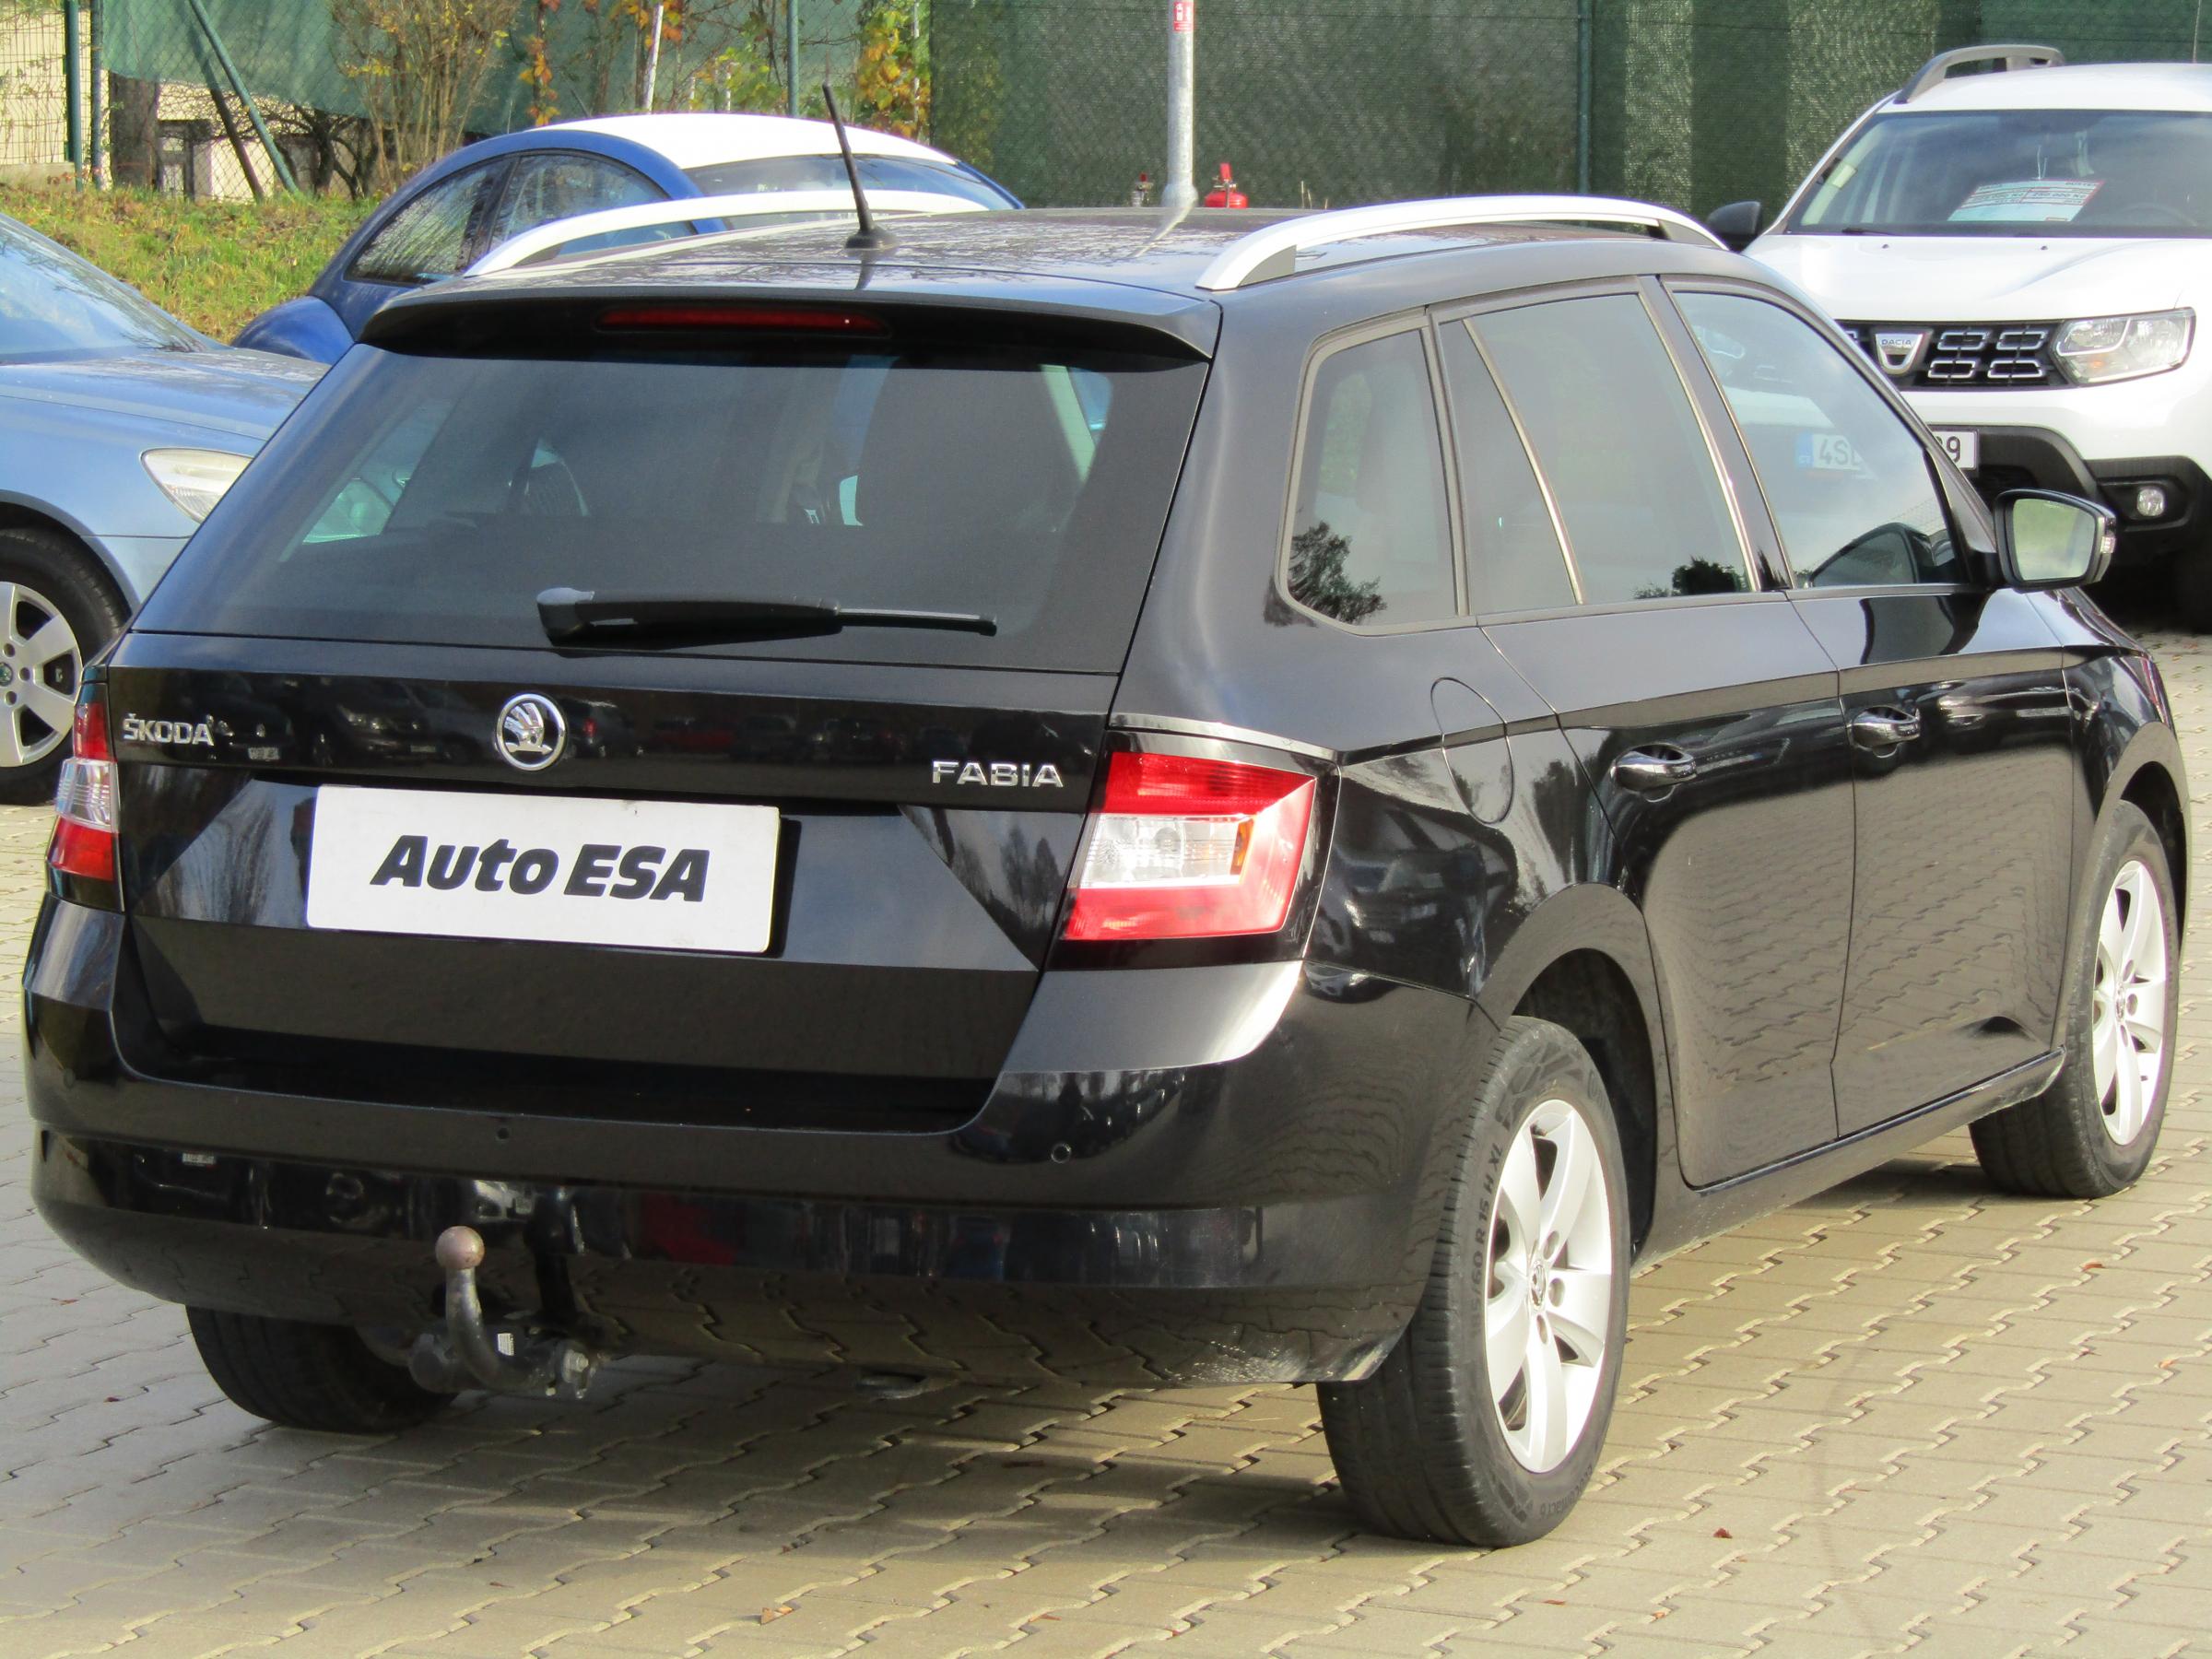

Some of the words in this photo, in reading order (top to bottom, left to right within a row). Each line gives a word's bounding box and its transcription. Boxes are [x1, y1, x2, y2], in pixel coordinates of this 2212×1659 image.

[123, 712, 215, 747] ŠKODA
[932, 760, 1064, 788] FABIA
[370, 834, 559, 896] Auto
[563, 843, 711, 902] ESA
